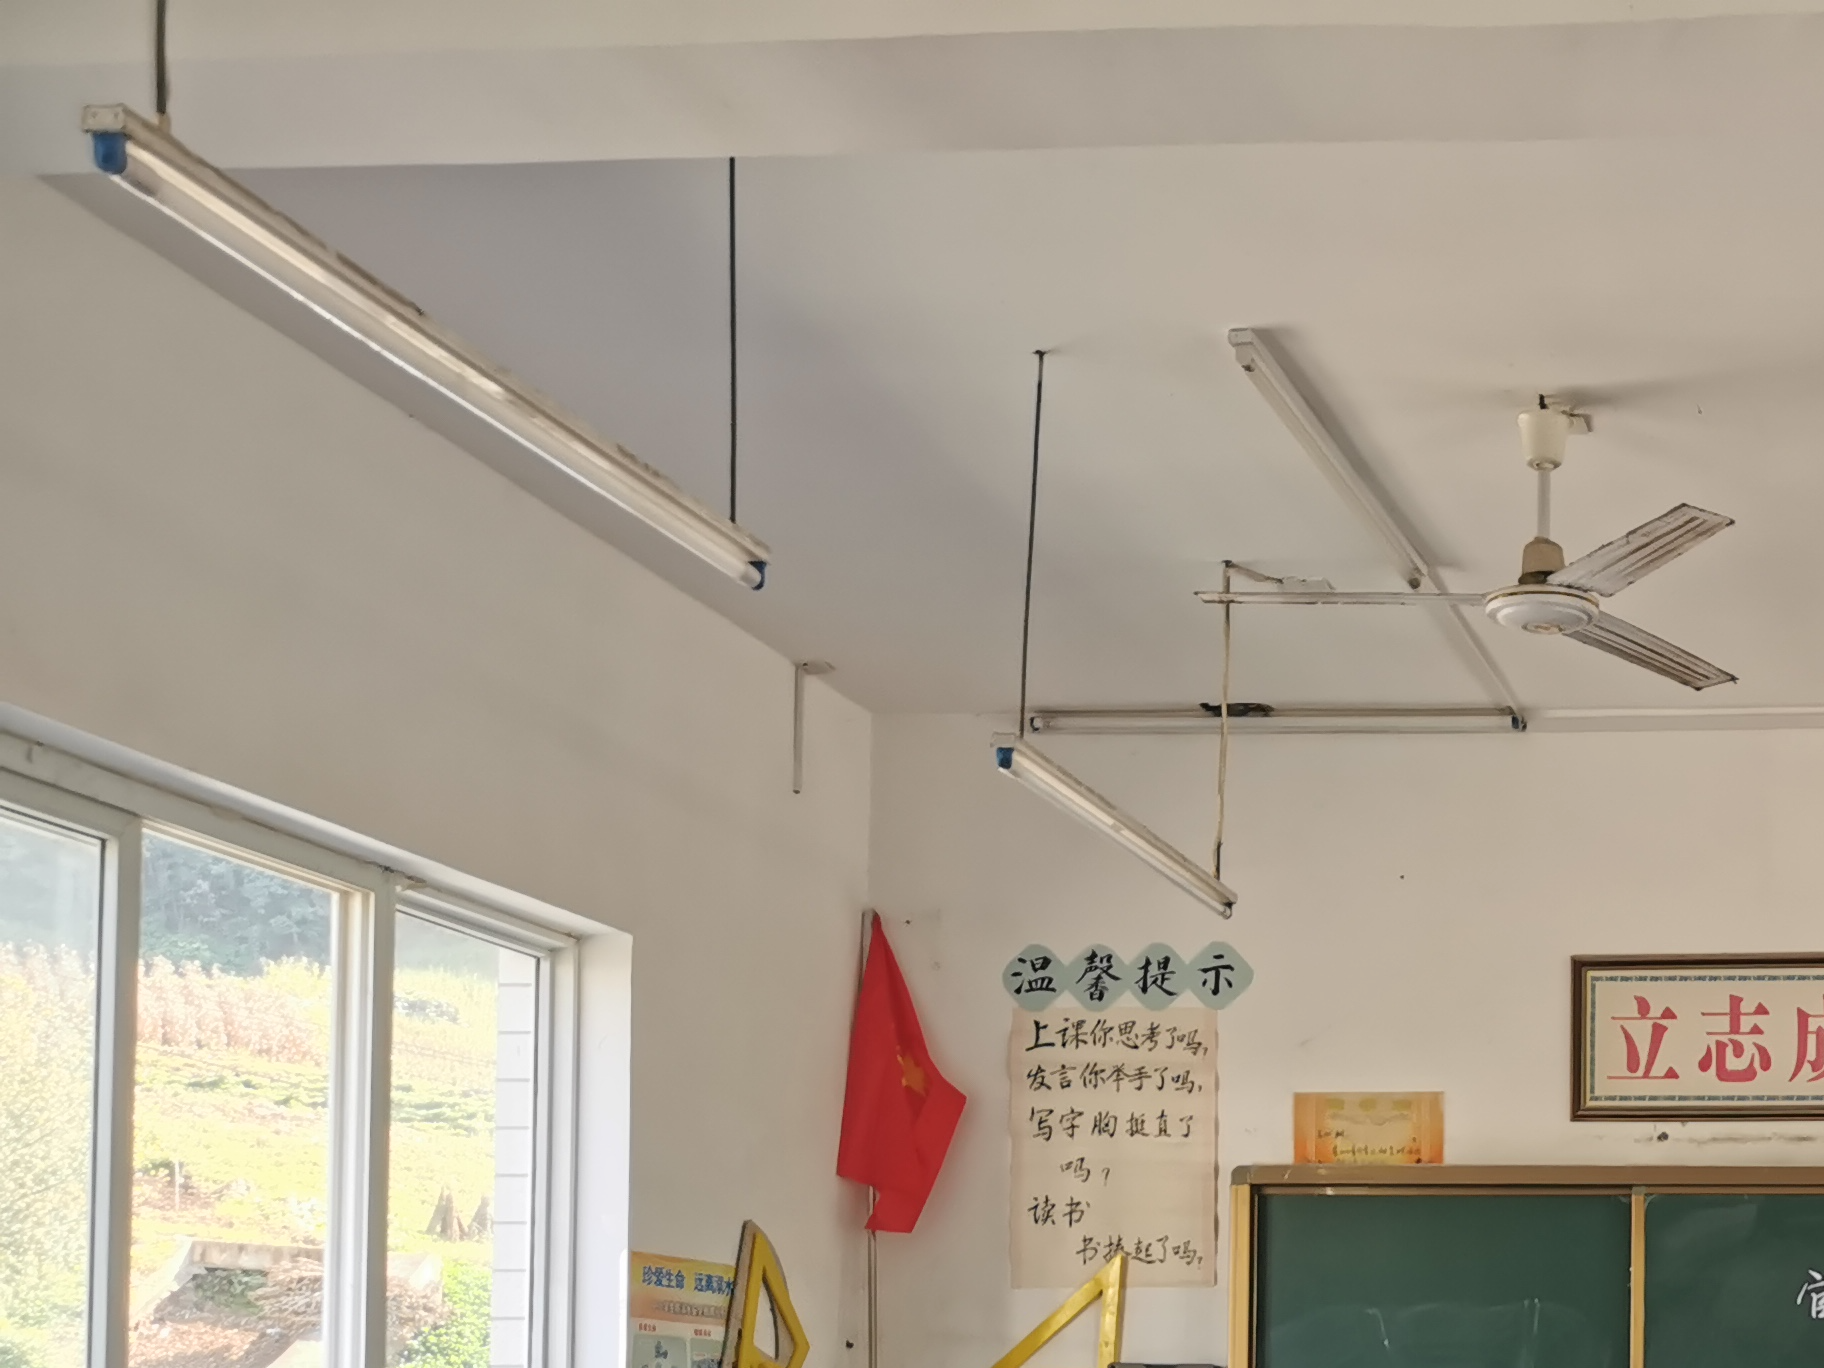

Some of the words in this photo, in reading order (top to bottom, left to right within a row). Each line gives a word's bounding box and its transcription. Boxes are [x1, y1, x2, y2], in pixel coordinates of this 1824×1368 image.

[1011, 949, 1236, 1003] 温馨提示
[1027, 1195, 1090, 1228] 读书
